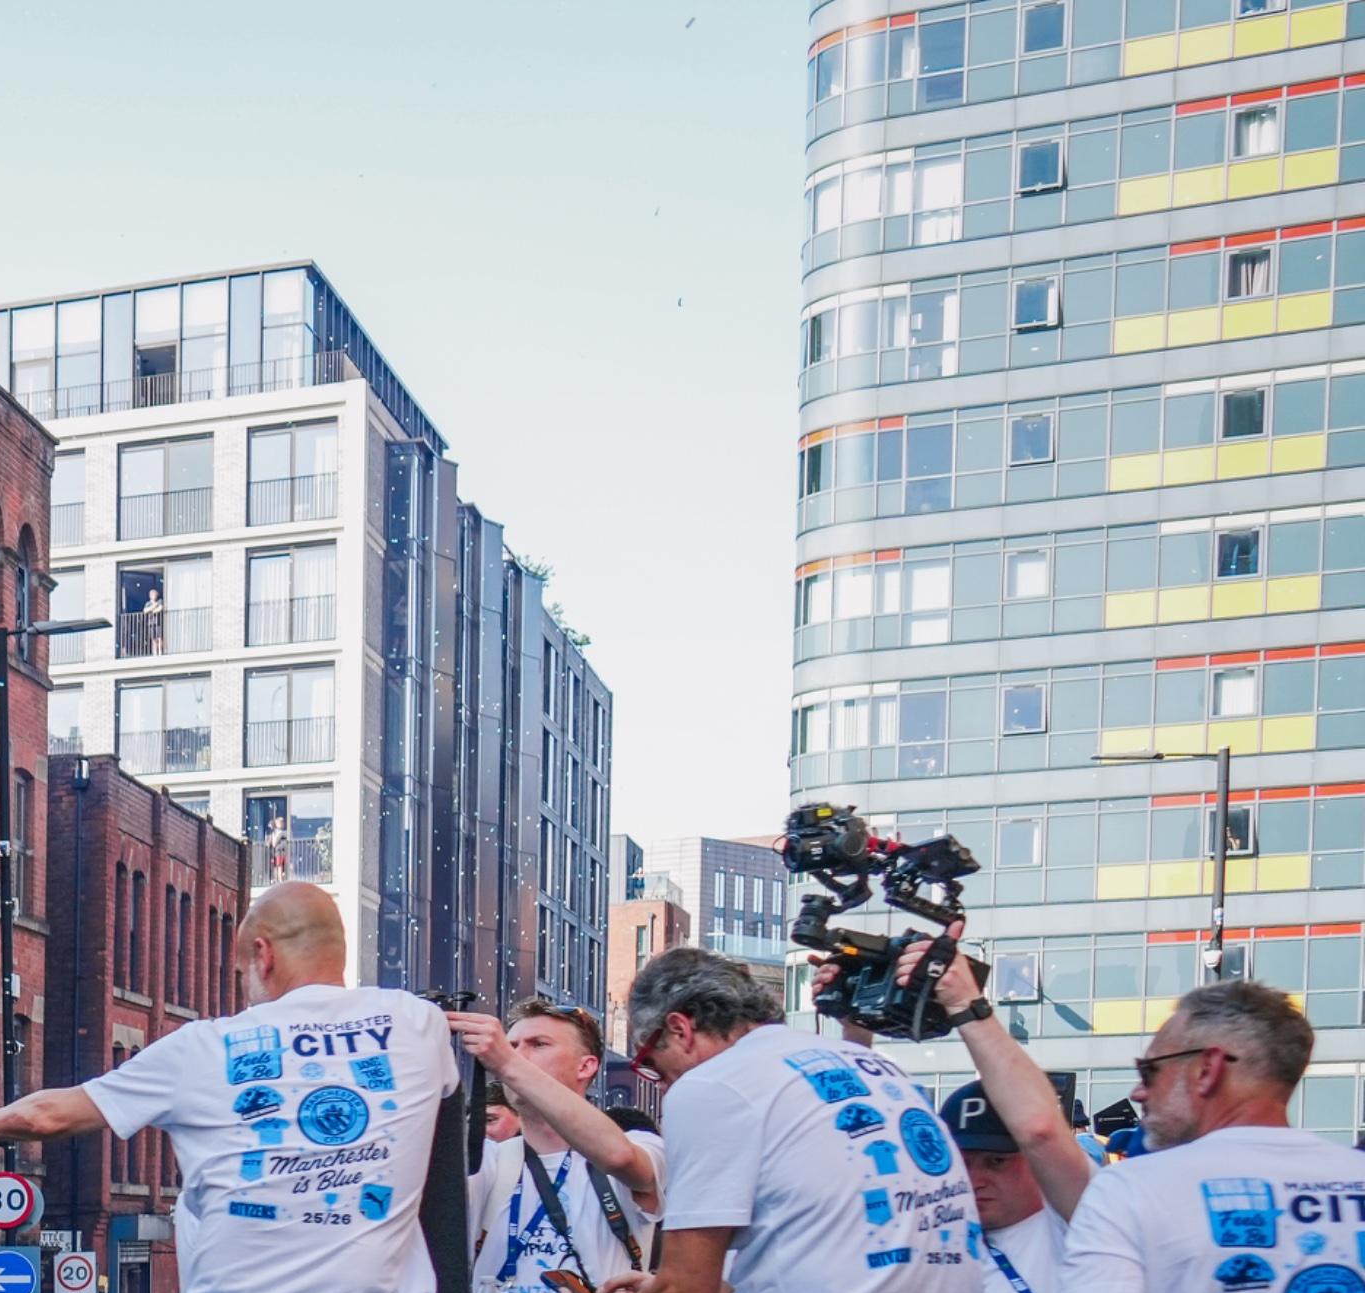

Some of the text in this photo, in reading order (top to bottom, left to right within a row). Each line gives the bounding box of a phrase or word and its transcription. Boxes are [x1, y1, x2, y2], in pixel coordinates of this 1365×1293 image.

[289, 1015, 392, 1033] MANCHESTER
[292, 1027, 393, 1057] CITY
[855, 1058, 909, 1079] CIT
[959, 1097, 987, 1130] P
[270, 1142, 391, 1175] Manchester
[292, 1170, 364, 1194] is Blue
[1284, 1181, 1365, 1192] MANCHE
[302, 1212, 352, 1226] 25/26
[1290, 1194, 1365, 1223] CIT
[63, 1266, 88, 1281] 20
